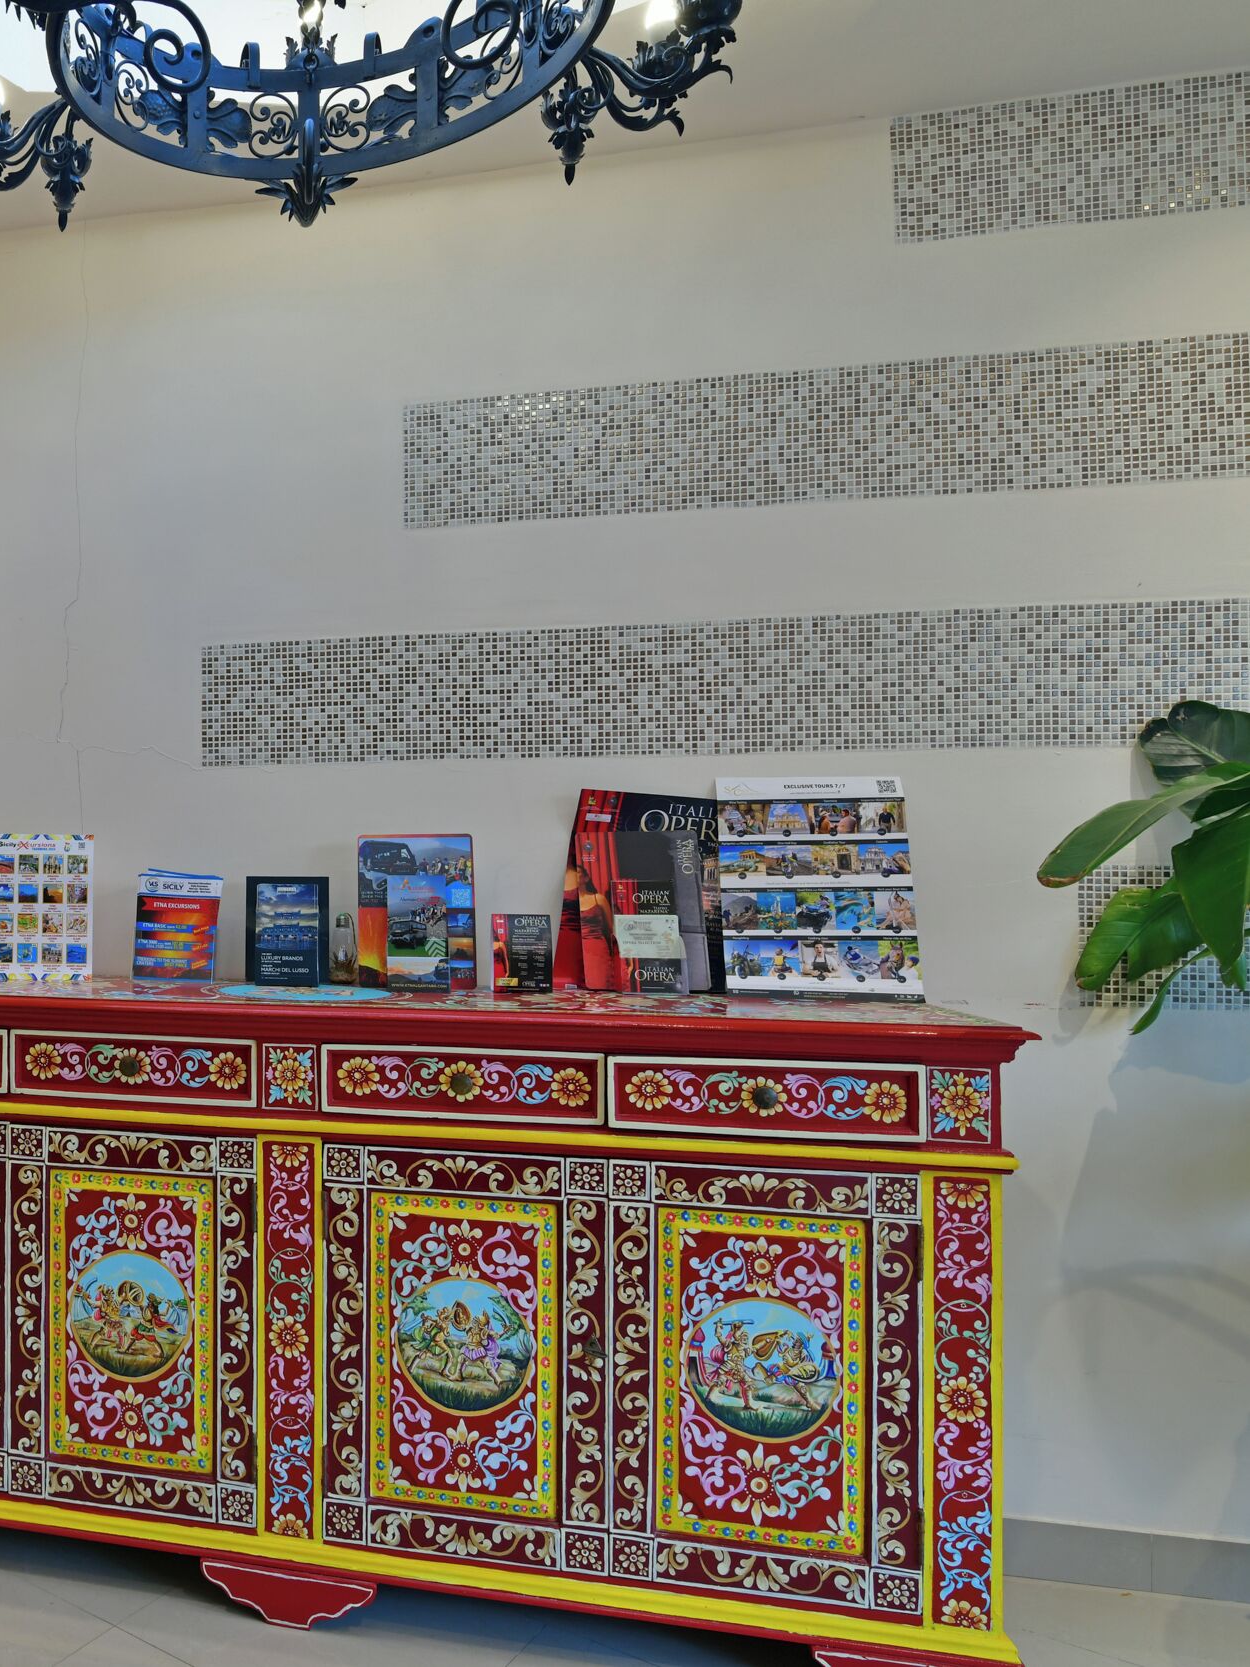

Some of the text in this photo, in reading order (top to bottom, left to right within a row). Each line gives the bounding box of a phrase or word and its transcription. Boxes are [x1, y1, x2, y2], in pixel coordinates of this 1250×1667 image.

[668, 803, 718, 818] ITALI
[681, 838, 695, 874] OPERA
[632, 893, 670, 904] OPERA
[514, 918, 548, 928] OPERA
[634, 969, 675, 982] OPERA
